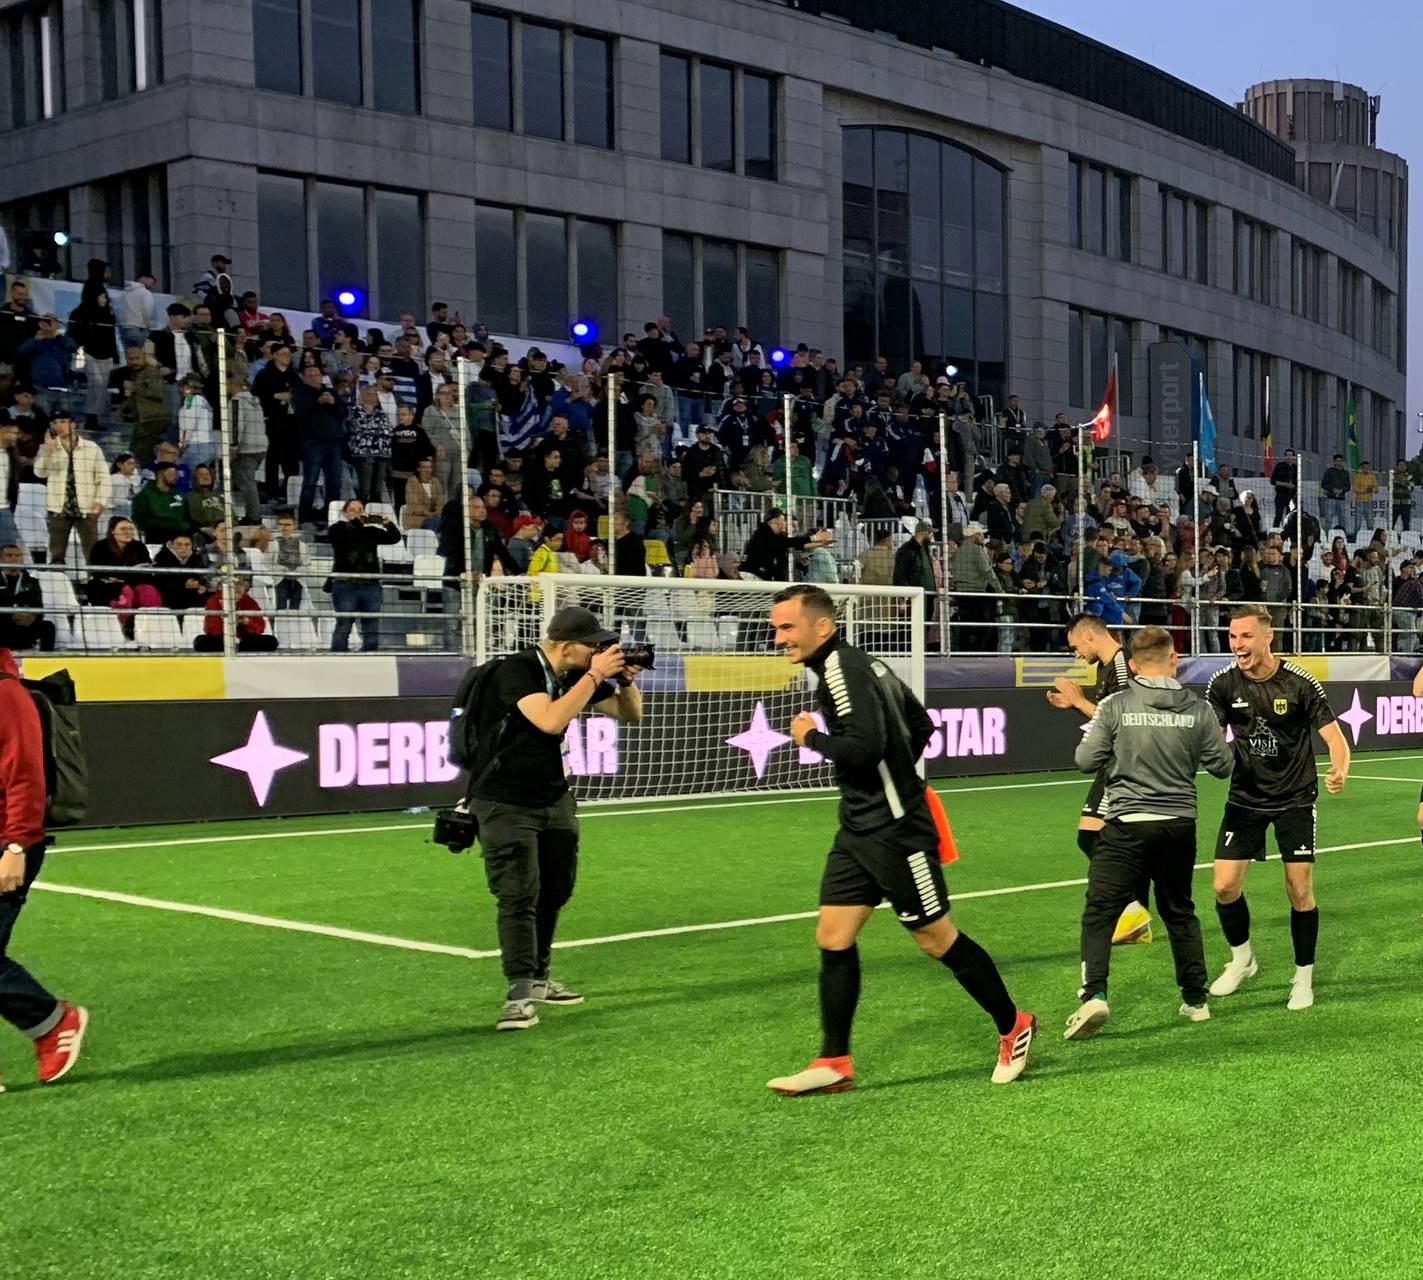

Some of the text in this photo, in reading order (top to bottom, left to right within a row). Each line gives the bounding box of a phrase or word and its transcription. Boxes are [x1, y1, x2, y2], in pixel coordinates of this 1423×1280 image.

[1121, 712, 1195, 729] DEUTSCHLAND
[1249, 736, 1278, 748] visit
[1224, 832, 1234, 846] 7
